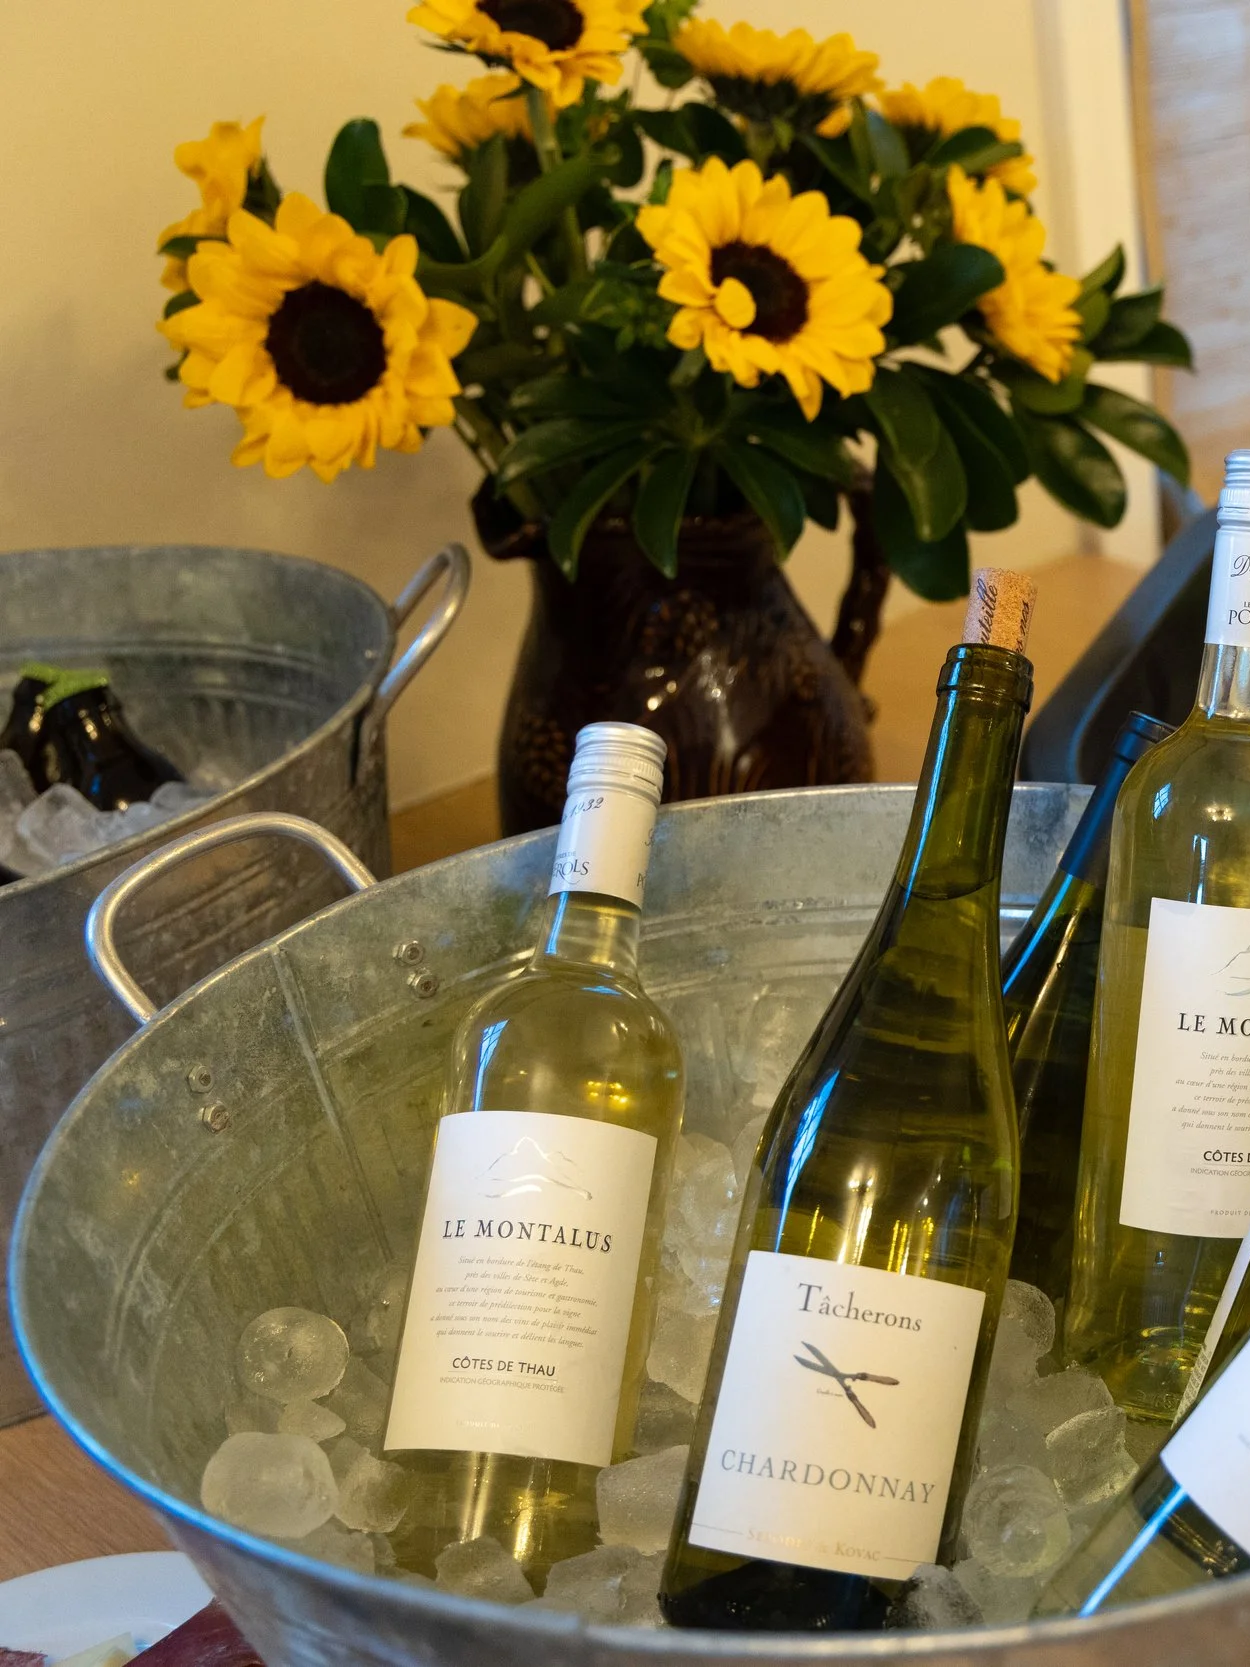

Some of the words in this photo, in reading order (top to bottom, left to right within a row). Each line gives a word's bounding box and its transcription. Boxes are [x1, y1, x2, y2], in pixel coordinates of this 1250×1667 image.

[977, 578, 998, 645] uteille
[570, 797, 604, 818] 1932
[1178, 1012, 1206, 1032] LE
[1200, 1052, 1220, 1060] Situé
[1210, 1068, 1224, 1076] près
[1226, 1068, 1236, 1076] des
[1206, 1080, 1226, 1088] d'une
[1227, 1082, 1248, 1092] région
[1227, 1096, 1236, 1104] de
[1178, 1104, 1200, 1114] donné
[1182, 1121, 1194, 1130] qui
[1196, 1120, 1224, 1130] donnent
[1226, 1123, 1232, 1131] le
[1204, 1150, 1243, 1162] CÔTES
[1190, 1168, 1229, 1176] INDICATION
[442, 1220, 466, 1238] LE
[474, 1220, 612, 1254] MONTALUS
[458, 1256, 476, 1264] Situé
[486, 1256, 514, 1266] bordure
[516, 1258, 524, 1267] de
[553, 1263, 562, 1271] de
[464, 1272, 479, 1280] près
[480, 1270, 490, 1279] des
[494, 1272, 510, 1280] villes
[480, 1287, 502, 1296] région
[504, 1287, 514, 1295] de
[514, 1290, 546, 1298] tourisme
[480, 1298, 488, 1308] de
[533, 1306, 552, 1314] pour
[554, 1306, 560, 1314] la
[562, 1308, 582, 1318] vigne
[798, 1282, 922, 1332] Tâcherons
[500, 1315, 512, 1324] des
[531, 1318, 540, 1326] de
[477, 1328, 484, 1336] le
[520, 1332, 546, 1342] délient
[548, 1335, 556, 1344] les
[452, 1356, 494, 1370] CÔTES
[497, 1360, 514, 1372] DE
[518, 1361, 556, 1377] THAU
[440, 1376, 476, 1384] INDICATION
[477, 1376, 532, 1390] GÉOGRAPHIQUE
[532, 1382, 564, 1394] PROTÉGÉE
[721, 1449, 936, 1504] CHARDONNAY
